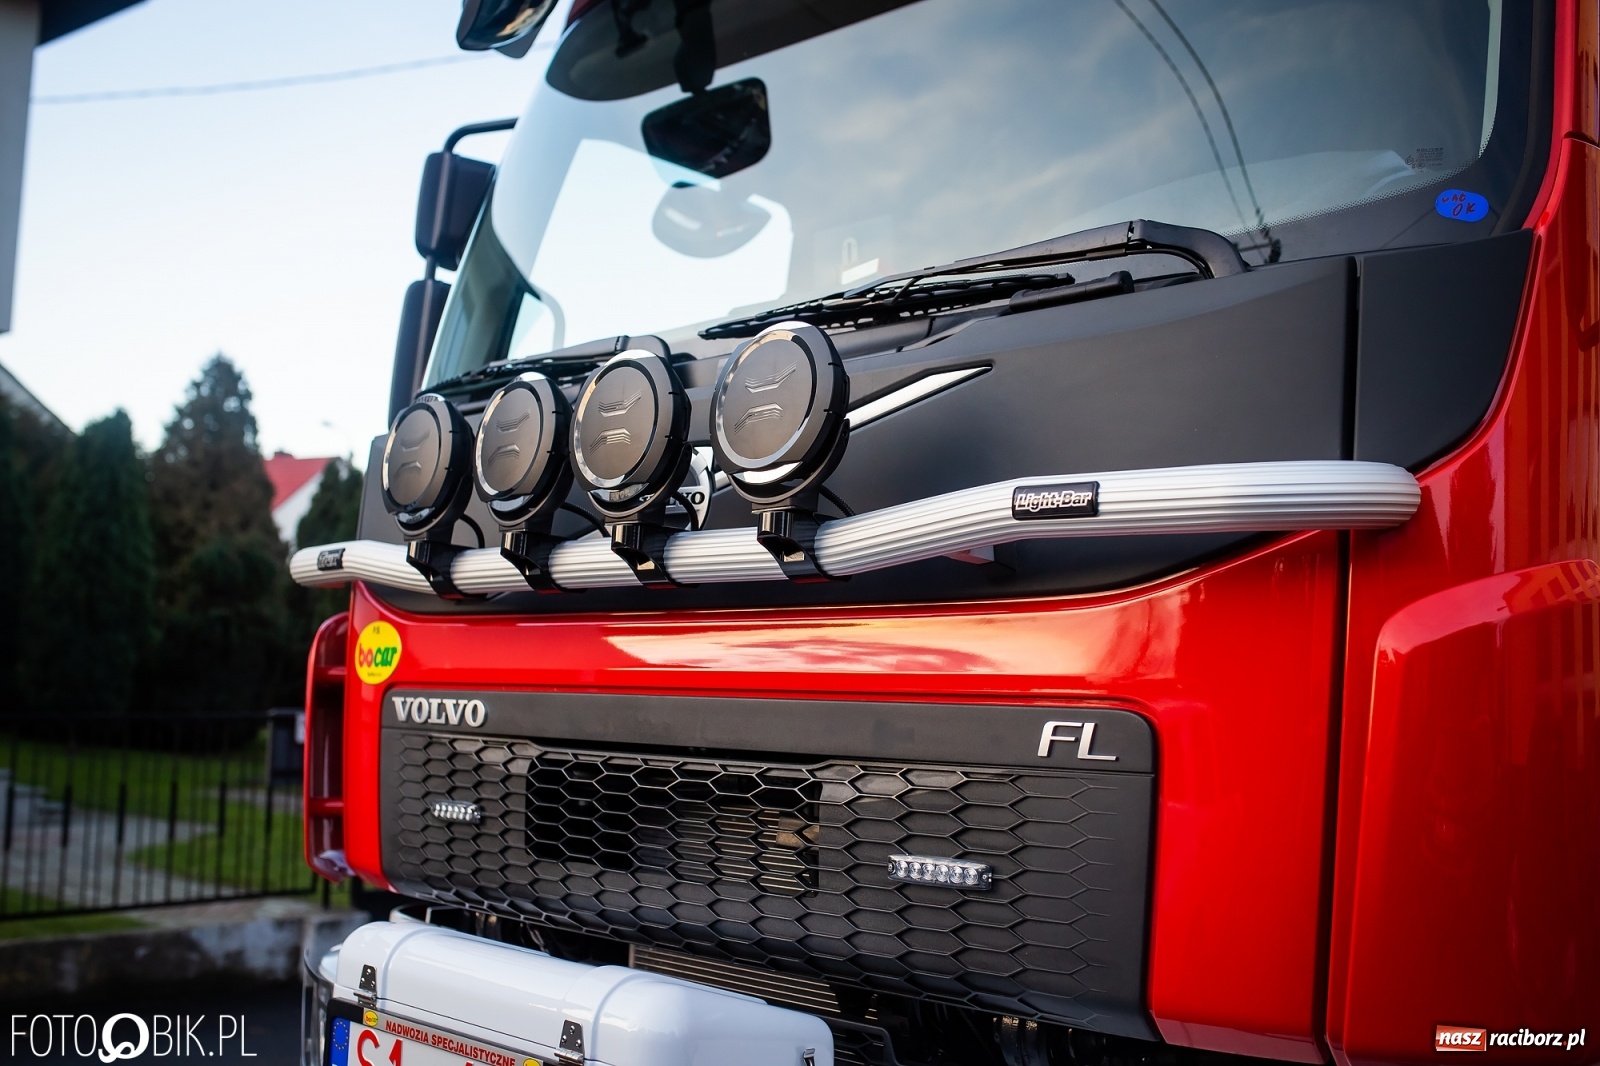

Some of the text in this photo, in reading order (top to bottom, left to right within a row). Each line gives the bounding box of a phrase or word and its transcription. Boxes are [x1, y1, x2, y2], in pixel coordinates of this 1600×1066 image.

[1453, 202, 1475, 216] OK
[1015, 490, 1092, 512] Light-Bar
[359, 643, 397, 668] bocar
[392, 696, 486, 727] VOLVO
[1037, 721, 1117, 761] FL
[385, 1020, 516, 1066] NADWOZIA SPECJALISTYCZNE
